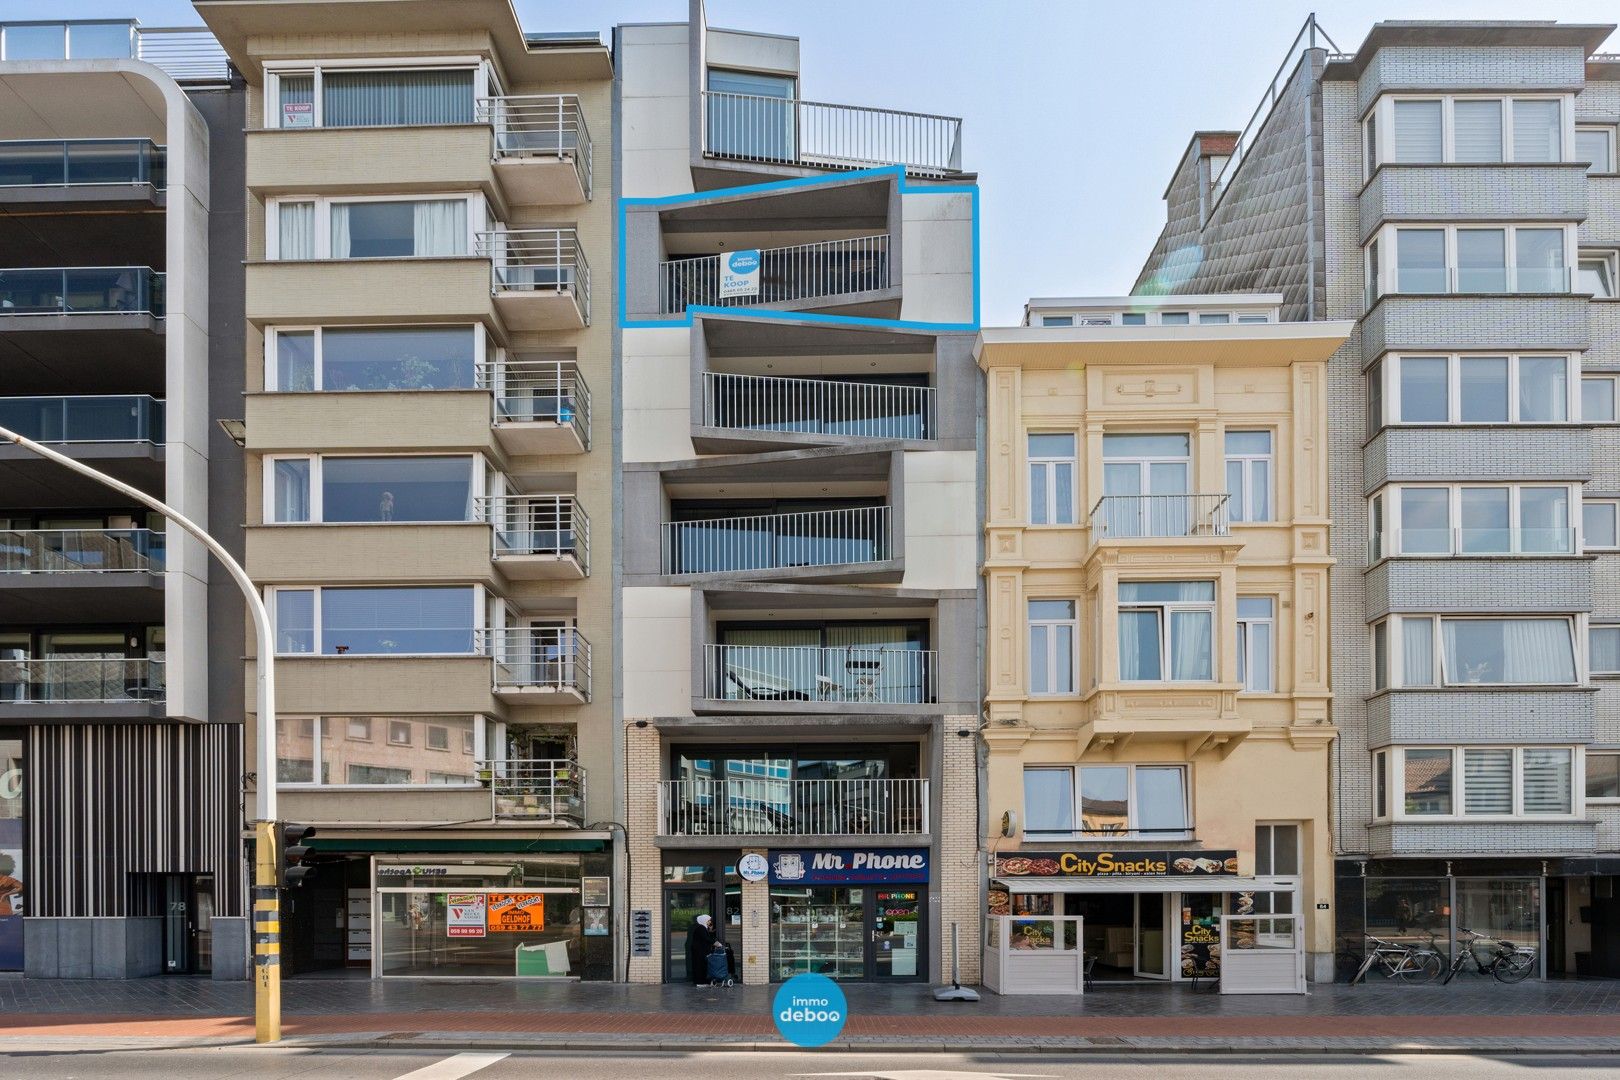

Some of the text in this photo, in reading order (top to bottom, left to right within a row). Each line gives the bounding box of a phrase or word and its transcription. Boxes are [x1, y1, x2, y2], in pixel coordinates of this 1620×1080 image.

[724, 280, 749, 288] KOOP
[852, 852, 926, 870] Phone
[1061, 853, 1166, 875] City Snacks
[170, 902, 186, 911] 78
[726, 906, 740, 915] 82
[885, 908, 910, 916] open
[501, 914, 531, 924] GELDHOF
[1023, 926, 1042, 938] City
[1192, 925, 1211, 935] City
[1184, 932, 1220, 942] Snacks
